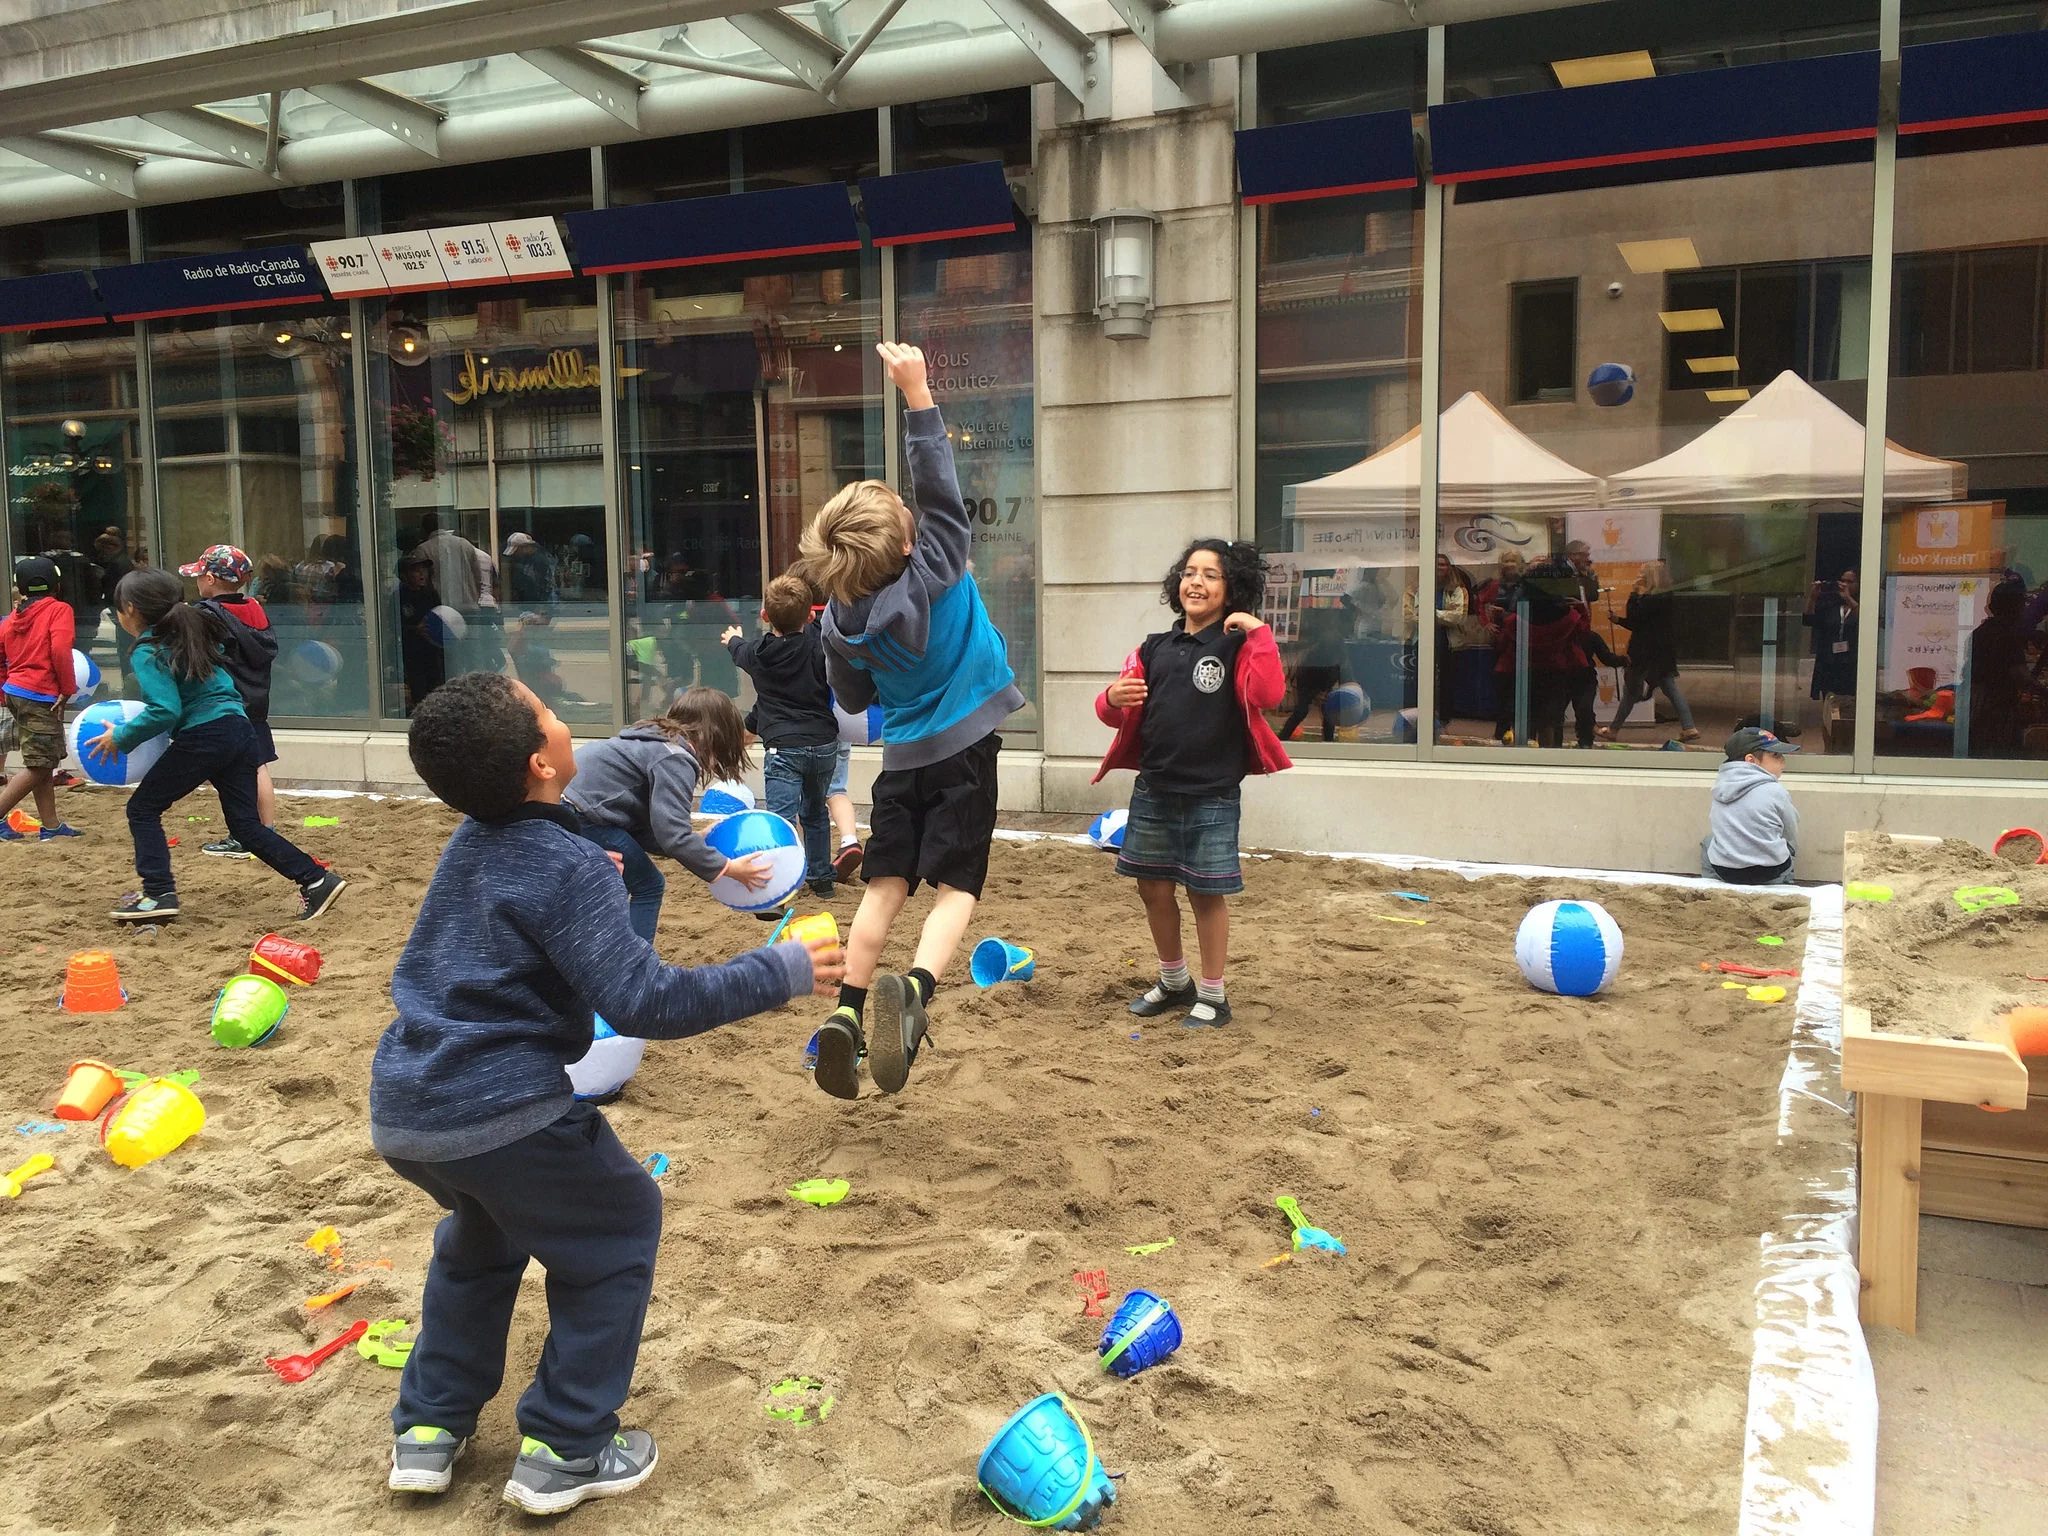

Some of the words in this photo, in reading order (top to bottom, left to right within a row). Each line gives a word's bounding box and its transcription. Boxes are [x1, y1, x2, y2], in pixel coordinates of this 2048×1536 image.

[394, 249, 431, 261] MUSIQUE
[461, 239, 485, 256] 91.5
[526, 242, 552, 258] 103.3
[183, 266, 214, 281] Radio
[215, 264, 229, 277] de
[228, 256, 300, 276] Radio-Canada
[253, 274, 275, 287] CBC
[274, 271, 306, 285] Radio
[924, 350, 969, 368] Vous
[926, 372, 999, 392] écoutez
[960, 420, 984, 433] You
[988, 420, 1009, 432] are
[959, 436, 1016, 451] listening
[1020, 435, 1033, 448] to
